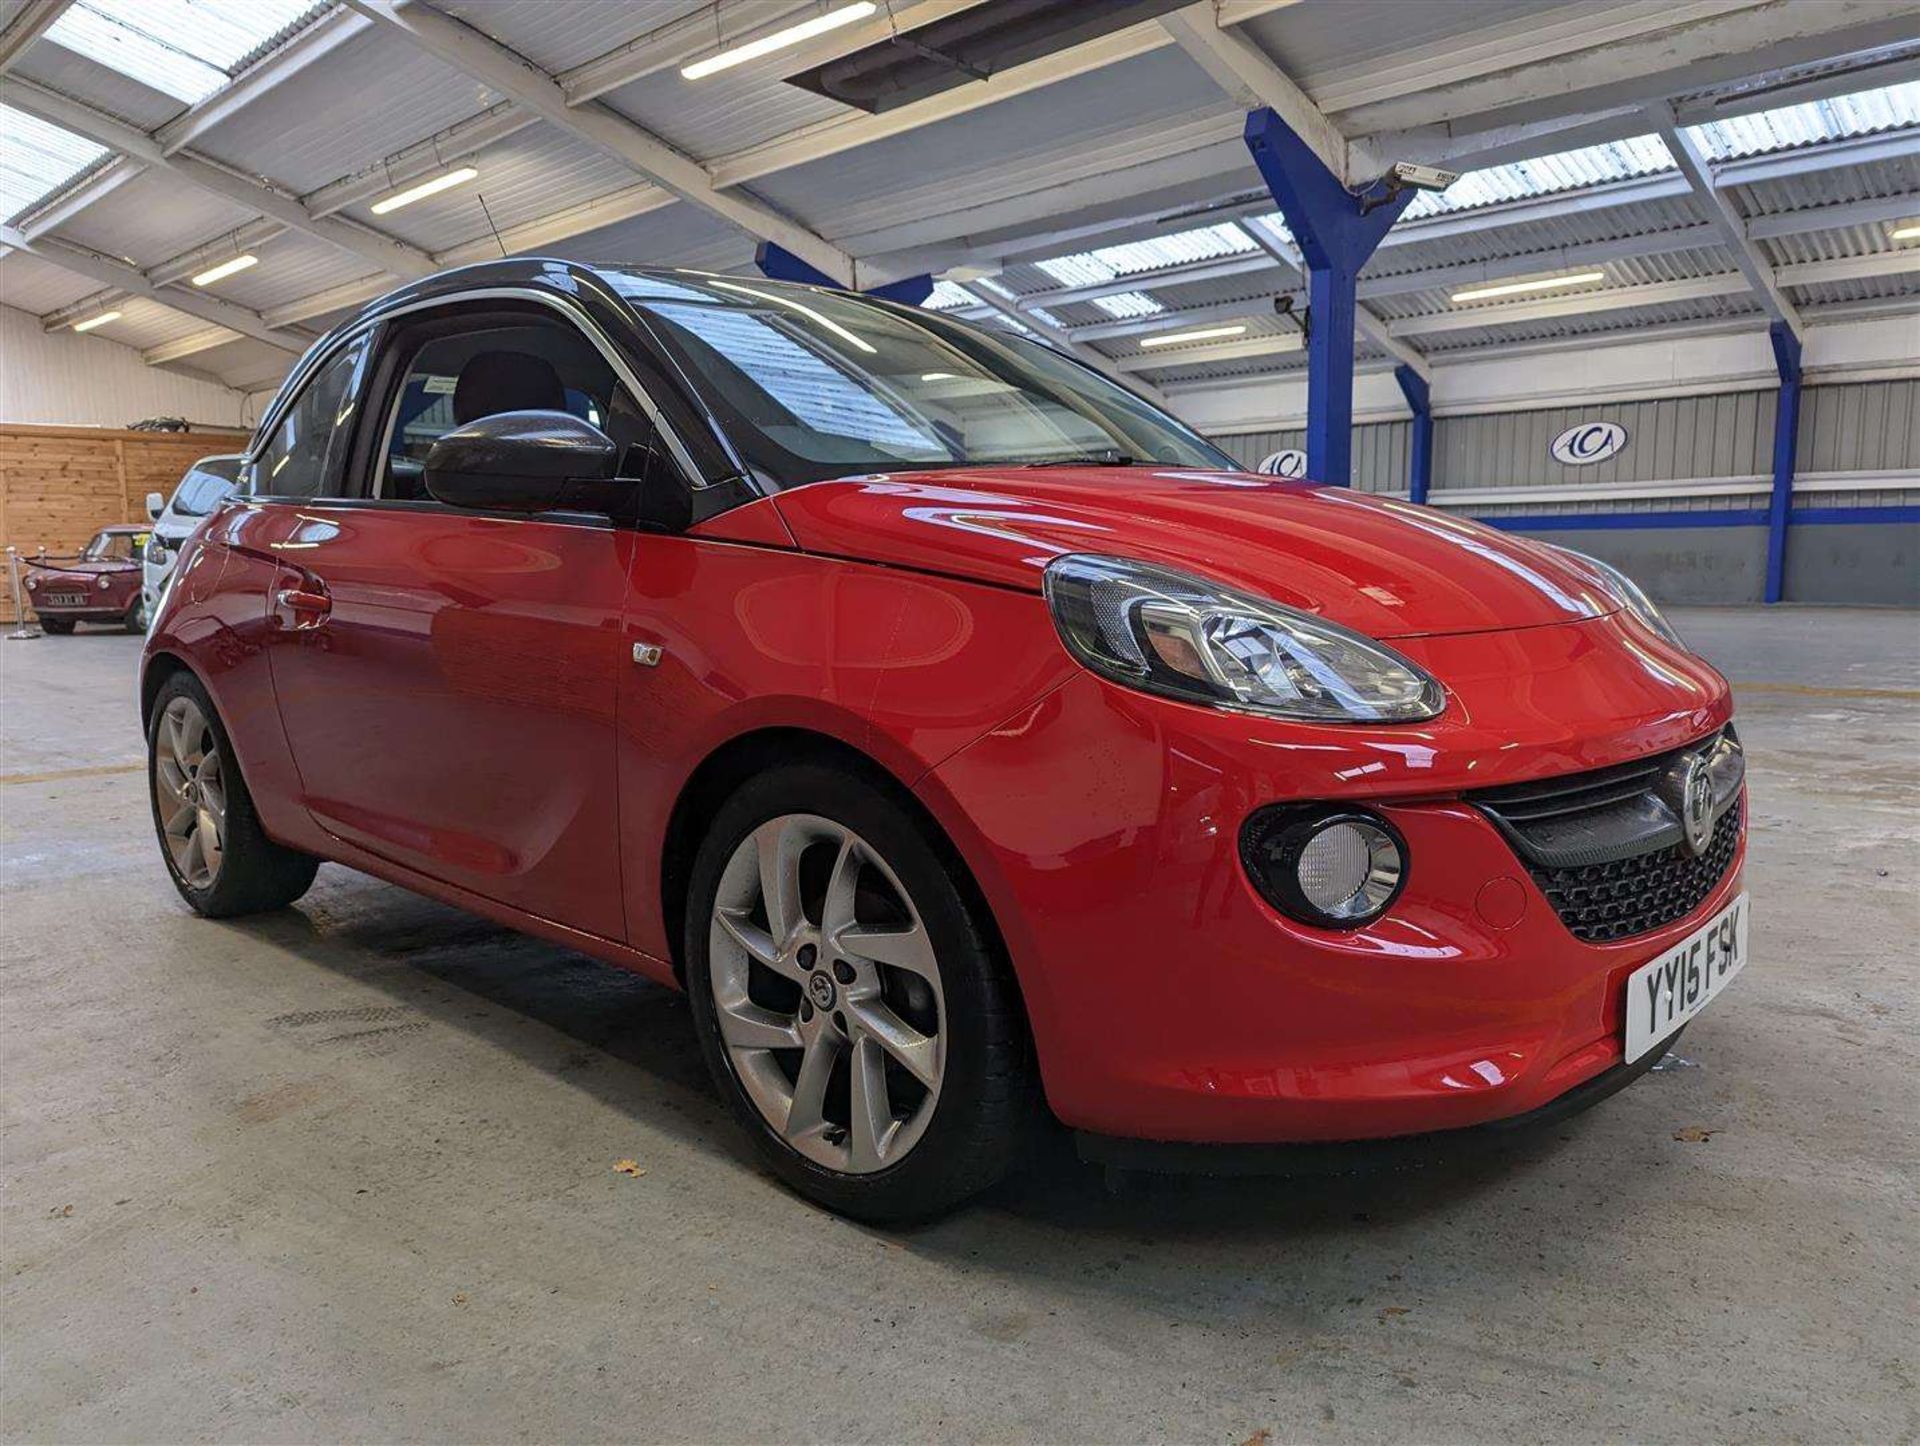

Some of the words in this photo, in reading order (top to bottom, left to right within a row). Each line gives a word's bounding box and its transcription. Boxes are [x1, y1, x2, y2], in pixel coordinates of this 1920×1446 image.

[1556, 426, 1615, 458] ACA
[1647, 939, 1701, 1034] YY15
[1706, 906, 1740, 990] FSK
